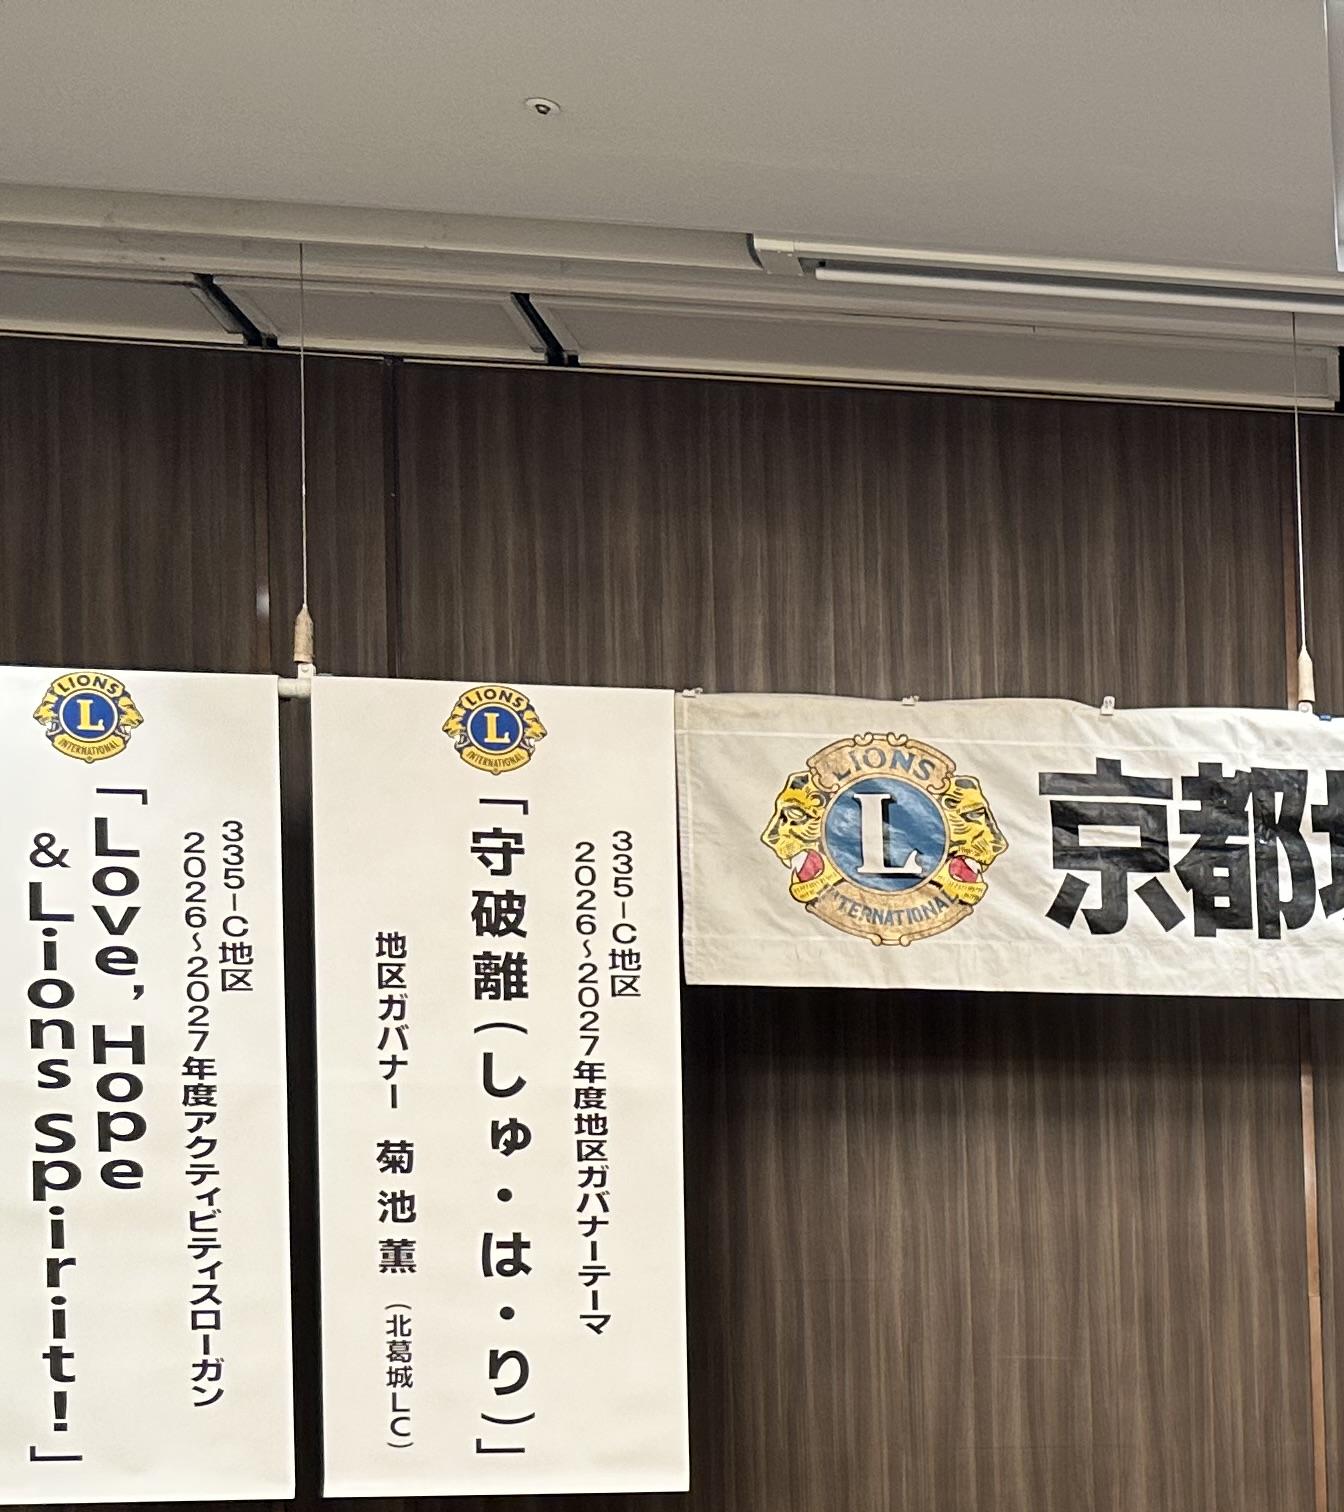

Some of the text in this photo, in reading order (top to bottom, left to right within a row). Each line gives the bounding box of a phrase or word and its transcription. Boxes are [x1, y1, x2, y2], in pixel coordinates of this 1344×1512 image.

[57, 675, 120, 694] LIONS
[465, 688, 524, 708] LIONS
[77, 699, 105, 731] L
[484, 712, 511, 743] L
[58, 739, 121, 756] INTERNATIONAL
[466, 750, 525, 768] INTERNATIONAL
[832, 748, 936, 781] LIONS
[29, 832, 70, 868] &
[853, 793, 923, 874] L
[817, 884, 957, 927] NTERNATIONA
[28, 881, 75, 1089] Lions
[375, 931, 409, 1109] 地区ガバナー
[92, 1024, 147, 1190] Hope
